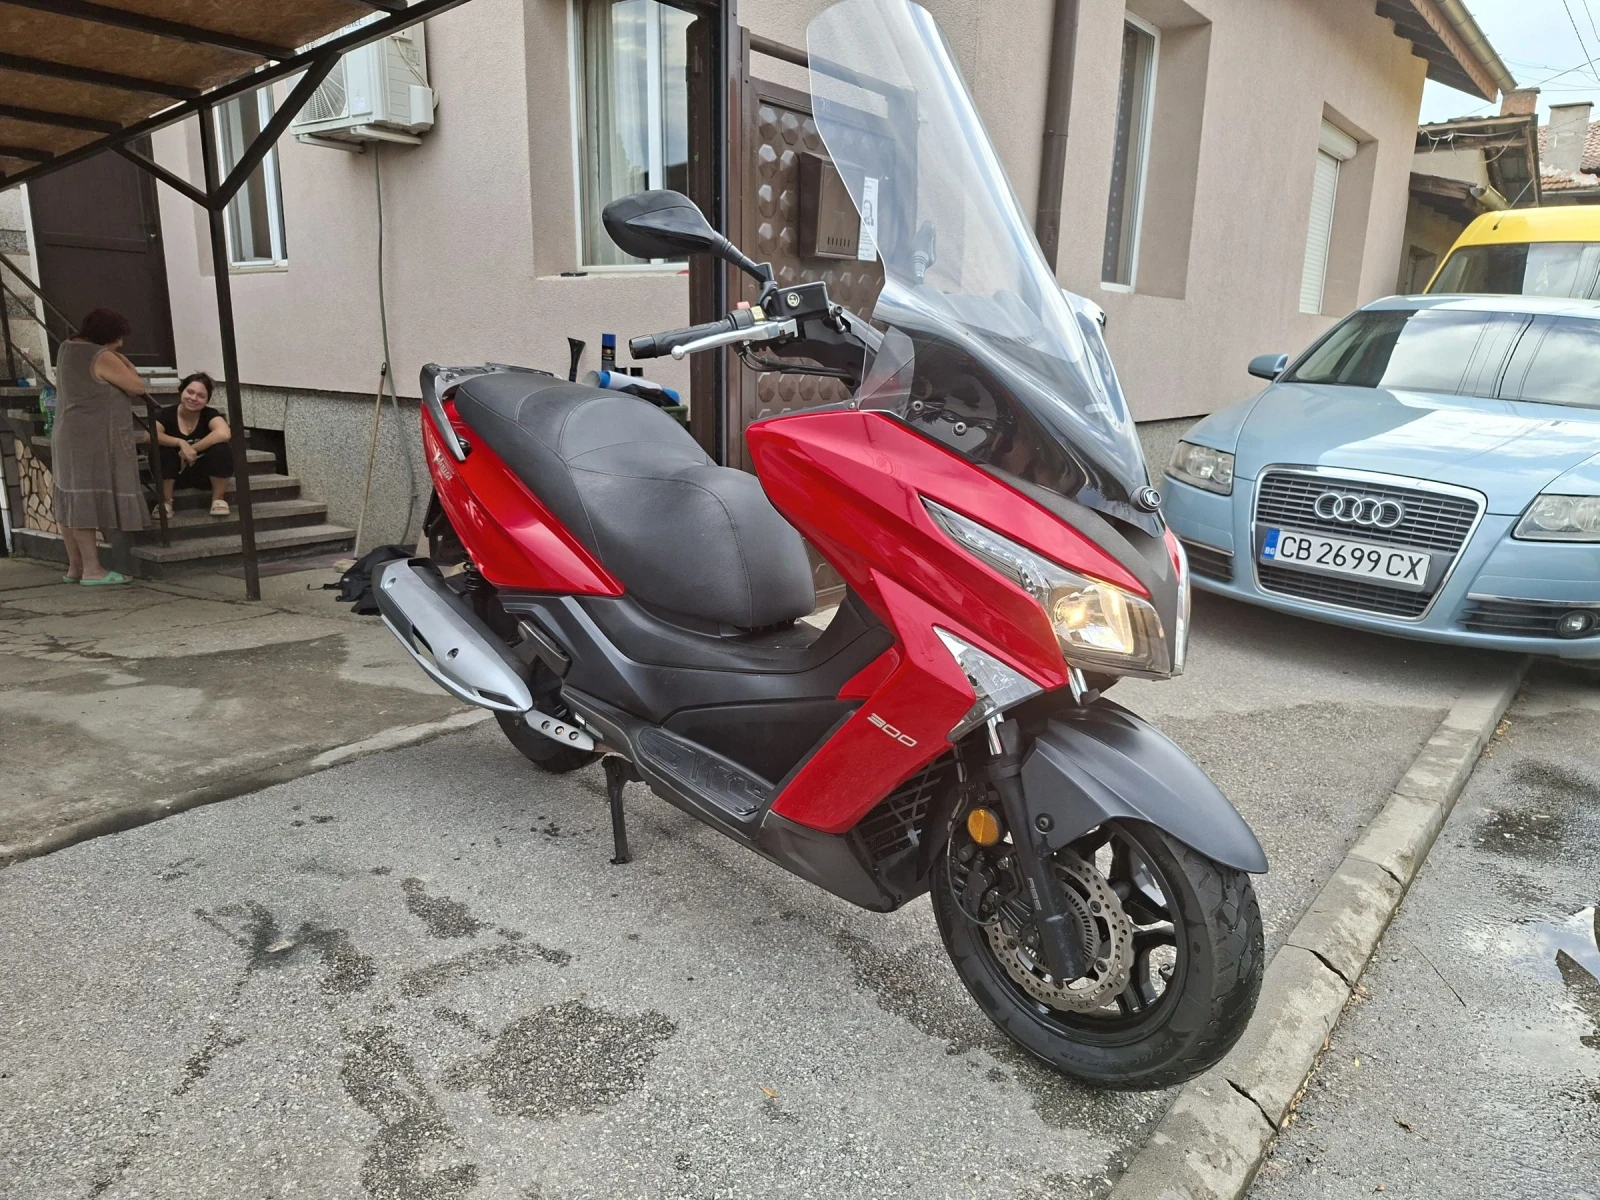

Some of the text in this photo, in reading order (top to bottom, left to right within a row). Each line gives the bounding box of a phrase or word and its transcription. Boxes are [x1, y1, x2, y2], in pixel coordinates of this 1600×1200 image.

[1264, 546, 1275, 555] BG
[1280, 536, 1424, 581] CB 2699 CX
[866, 712, 918, 748] 300
[1027, 877, 1042, 911] ABS
